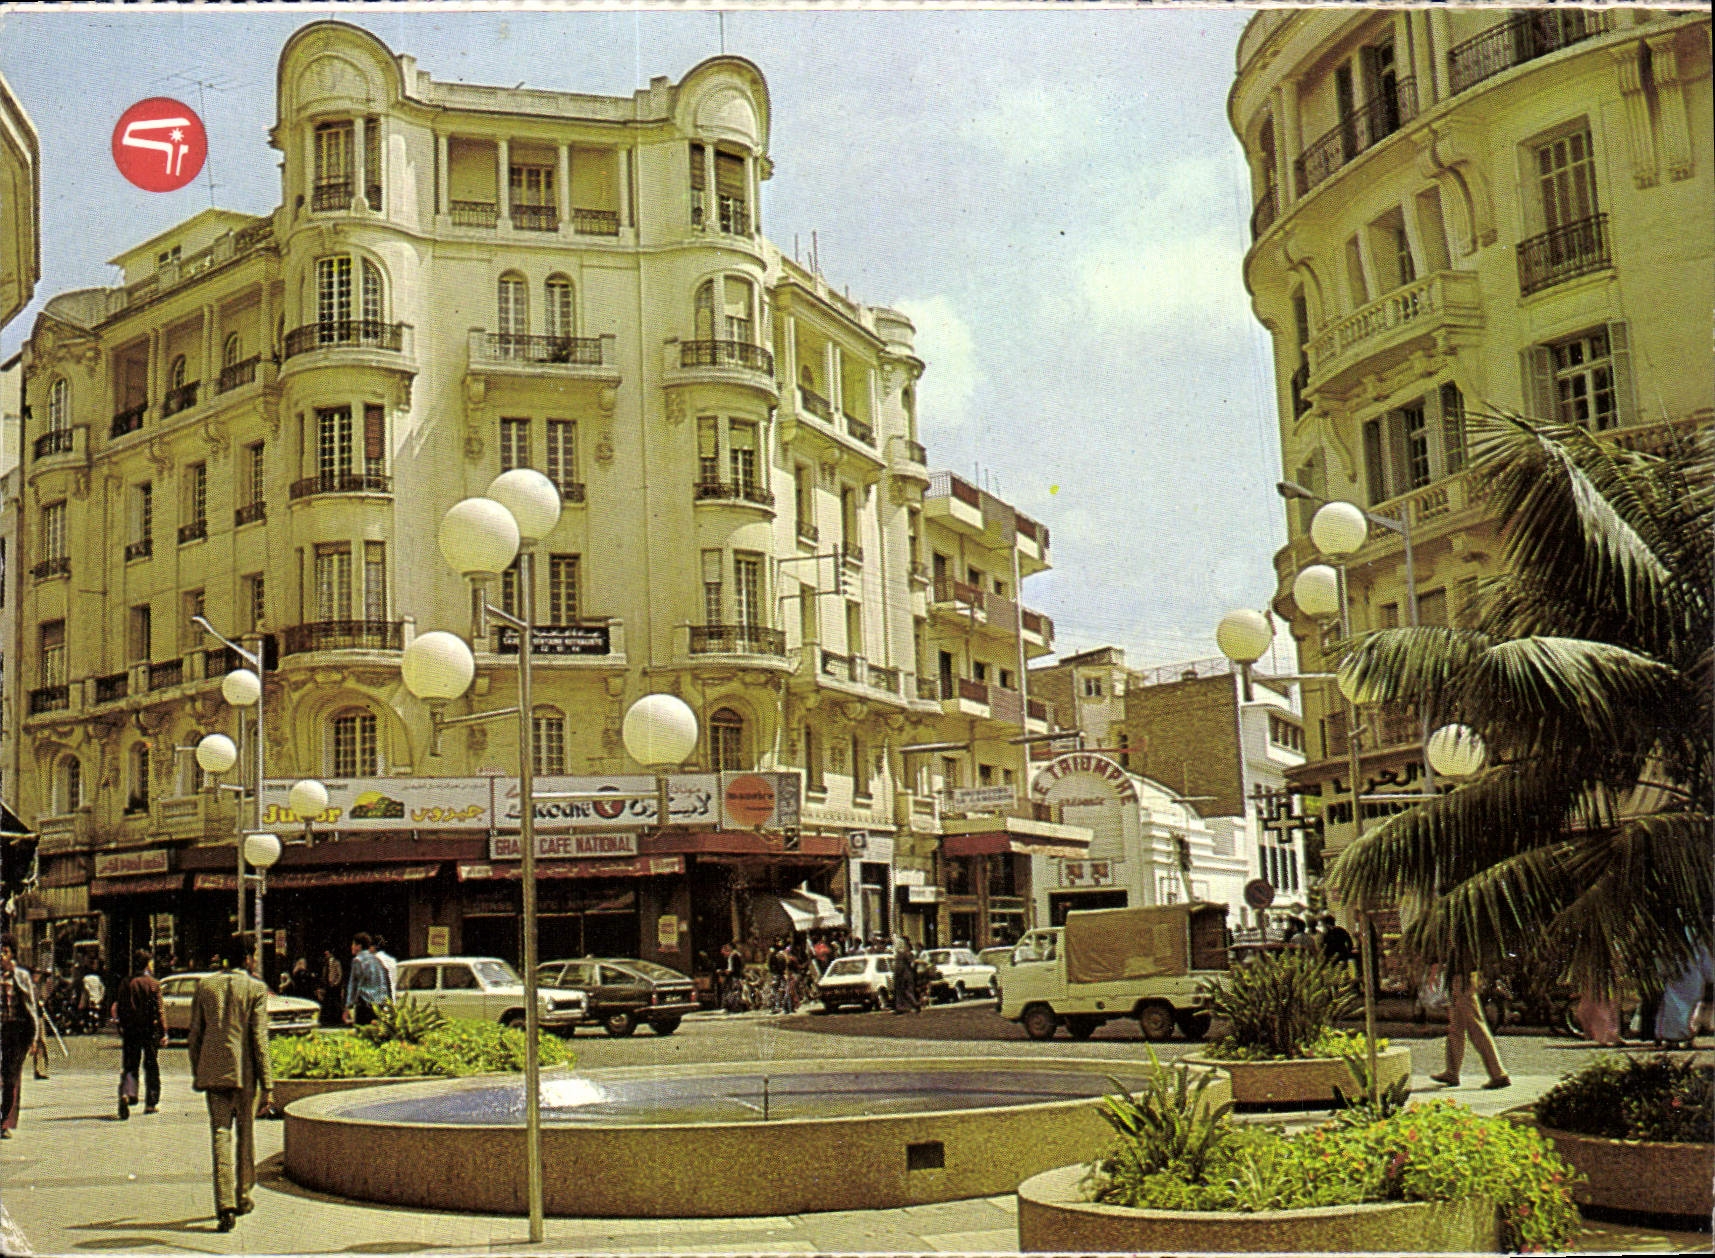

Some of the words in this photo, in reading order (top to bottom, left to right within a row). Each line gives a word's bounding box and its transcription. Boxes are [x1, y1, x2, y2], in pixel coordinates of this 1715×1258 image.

[1044, 756, 1139, 806] TRIOMPHE
[495, 838, 527, 855] GRA
[539, 837, 571, 854] CAFE
[575, 835, 634, 853] NATIONAL
